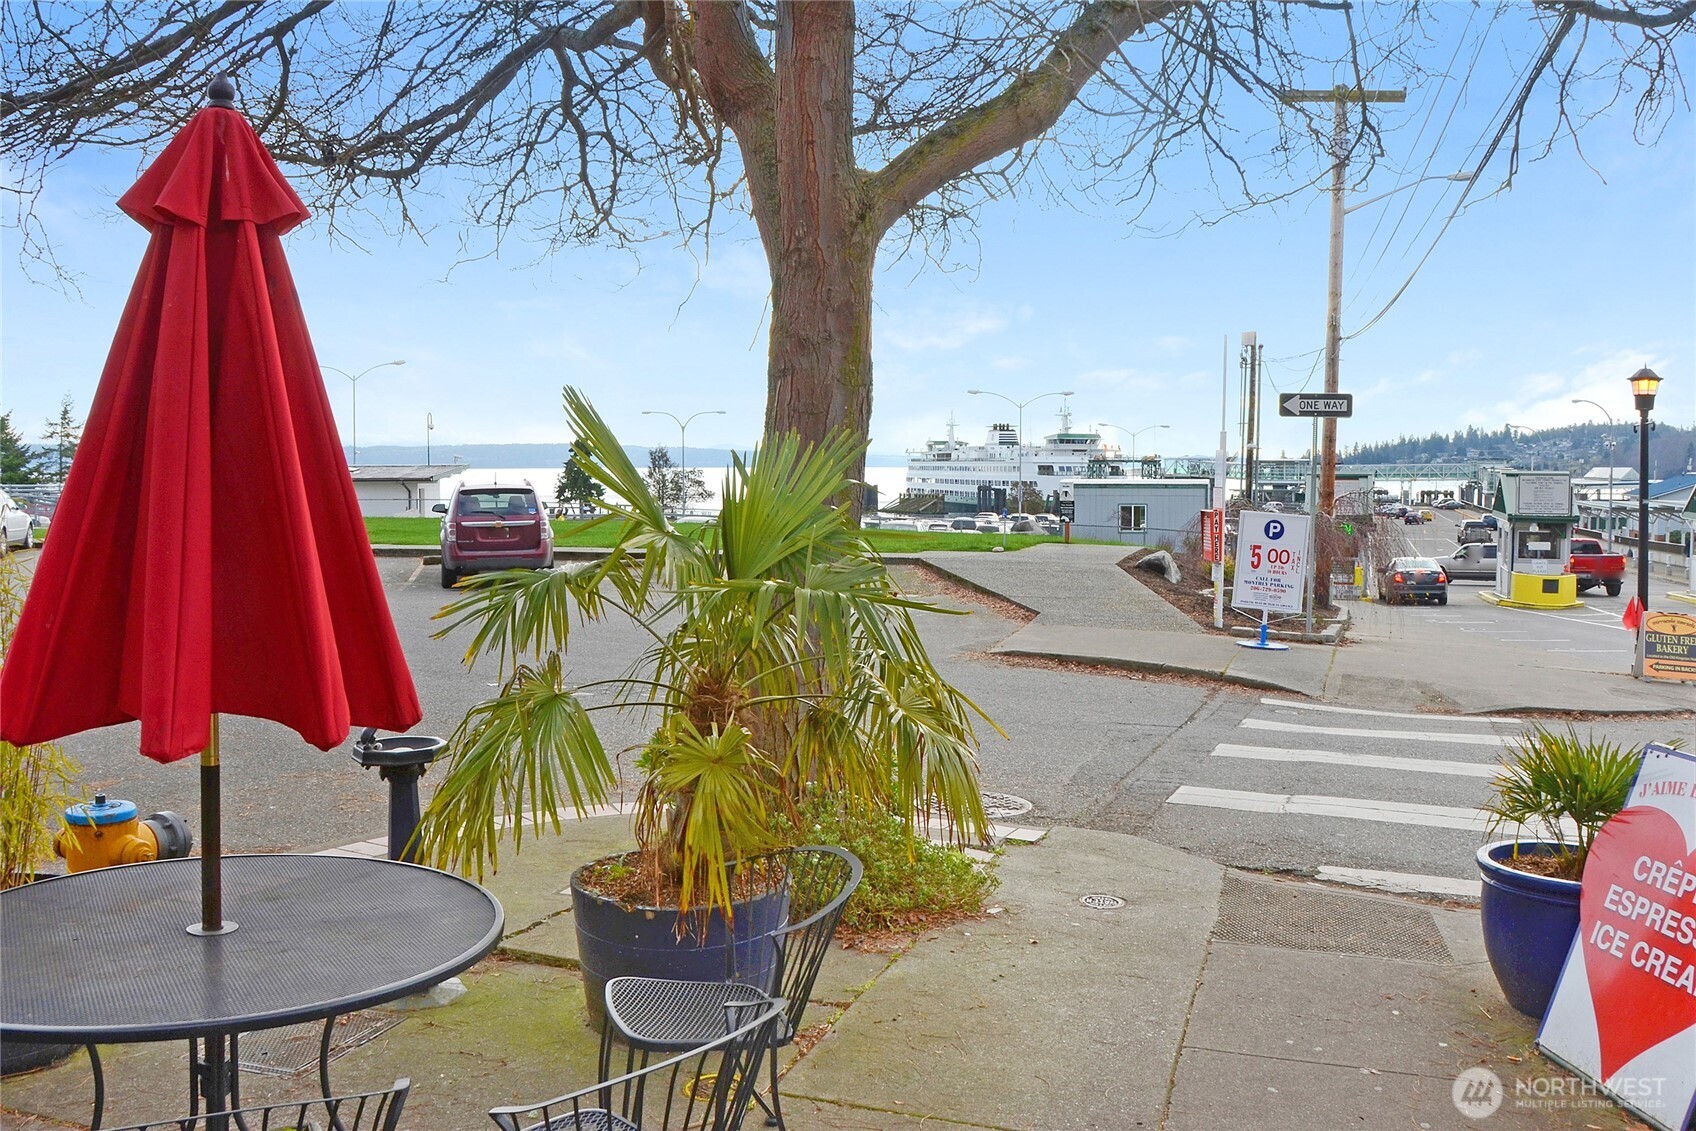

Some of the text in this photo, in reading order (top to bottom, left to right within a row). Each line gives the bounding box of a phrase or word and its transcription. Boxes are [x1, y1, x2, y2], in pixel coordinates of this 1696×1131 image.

[1299, 401, 1344, 410] ONE WAY
[1269, 522, 1281, 537] P
[1646, 634, 1678, 644] GLUTEN
[1656, 644, 1688, 654] BAKERY
[1639, 781, 1688, 798] J'AIME
[1633, 856, 1696, 904] CRÊP
[1604, 884, 1696, 949] ESPRES
[1589, 920, 1696, 996] ICE CREA
